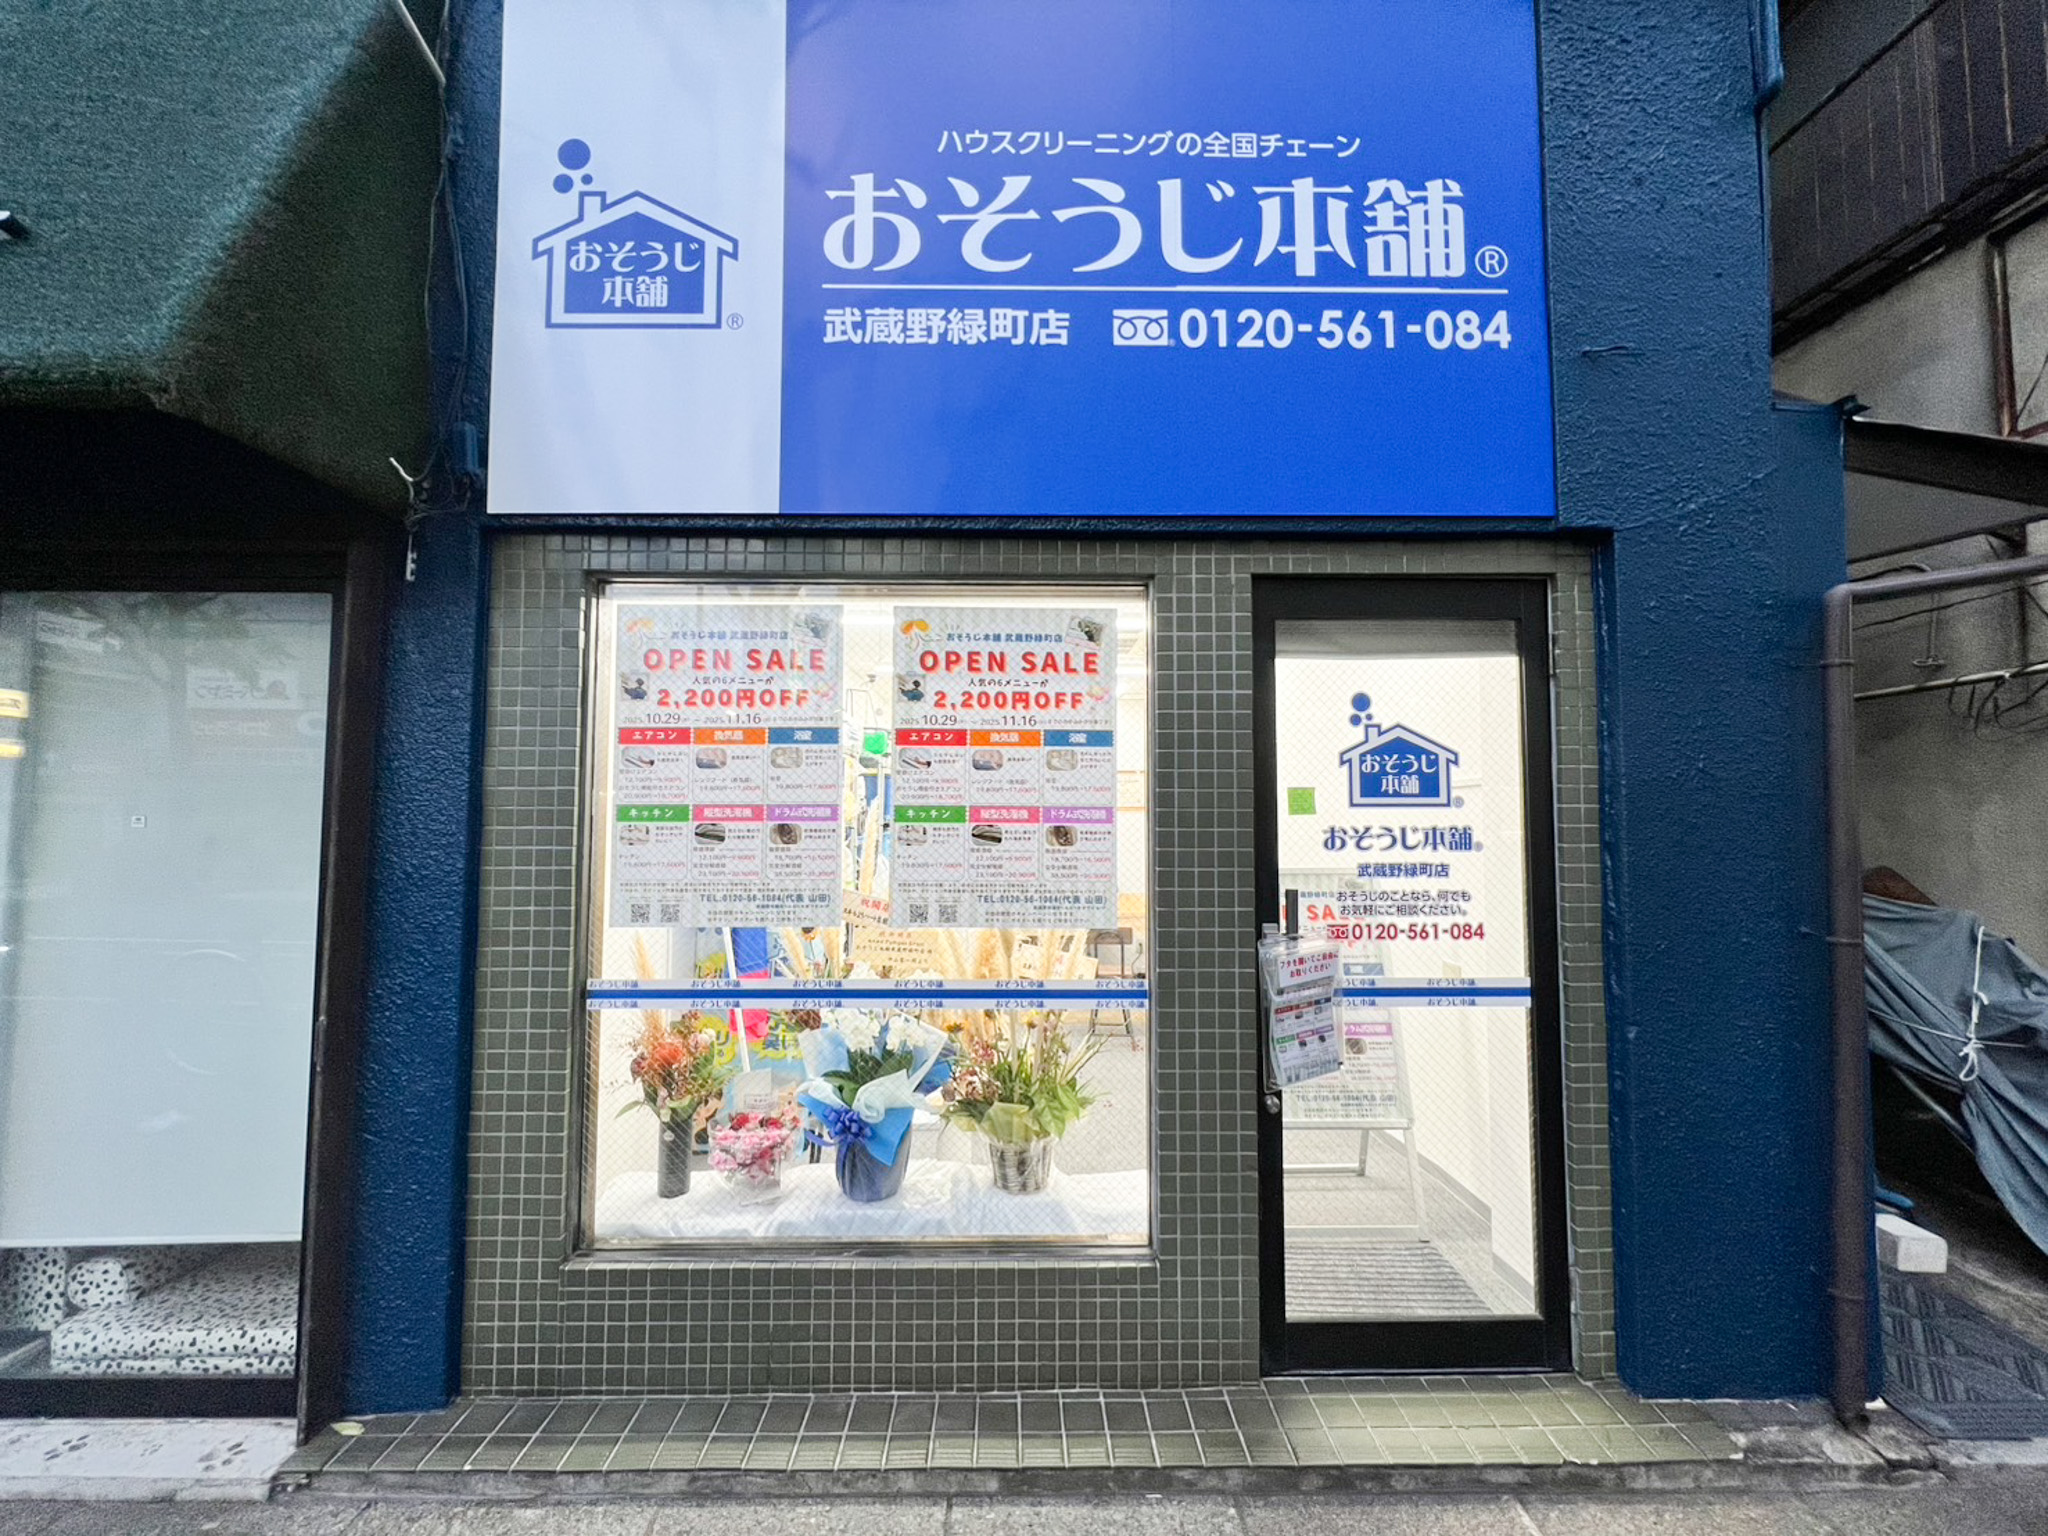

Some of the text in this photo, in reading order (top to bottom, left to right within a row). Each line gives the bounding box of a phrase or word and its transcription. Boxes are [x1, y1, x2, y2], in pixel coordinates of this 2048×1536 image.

[937, 131, 1361, 159] ハウスクリーニングの全国チェーン
[823, 173, 1466, 279] おそうじ本舗
[569, 240, 701, 273] おそうじ
[602, 275, 668, 308] 本舗
[823, 307, 1070, 346] 武蔵野緑町店
[1179, 308, 1511, 350] 0120-561-084
[946, 633, 1001, 643] おそうじ本舗
[643, 647, 827, 672] OPEN SALE
[919, 650, 1100, 674] OPEN SALE
[692, 675, 775, 686] 人気の6メニューが
[968, 678, 1049, 688] 人気の6メニューが
[657, 688, 812, 709] 2,200円OFF
[934, 690, 1085, 710] 2,200円OFF
[632, 730, 677, 740] エアコン
[909, 732, 954, 742] エアコン
[1361, 753, 1438, 773] おそうじ
[1381, 775, 1419, 795] 本舗
[629, 808, 674, 818] キッチン
[906, 809, 951, 819] キッチン
[1322, 825, 1472, 852] おそうじ本舗
[1357, 863, 1450, 878] 武蔵野緑町店
[1337, 890, 1471, 902] おそうじのことなら、何でも
[1340, 904, 1467, 916] お気軽にご相談ください。
[1352, 923, 1485, 940] 0120-561-084
